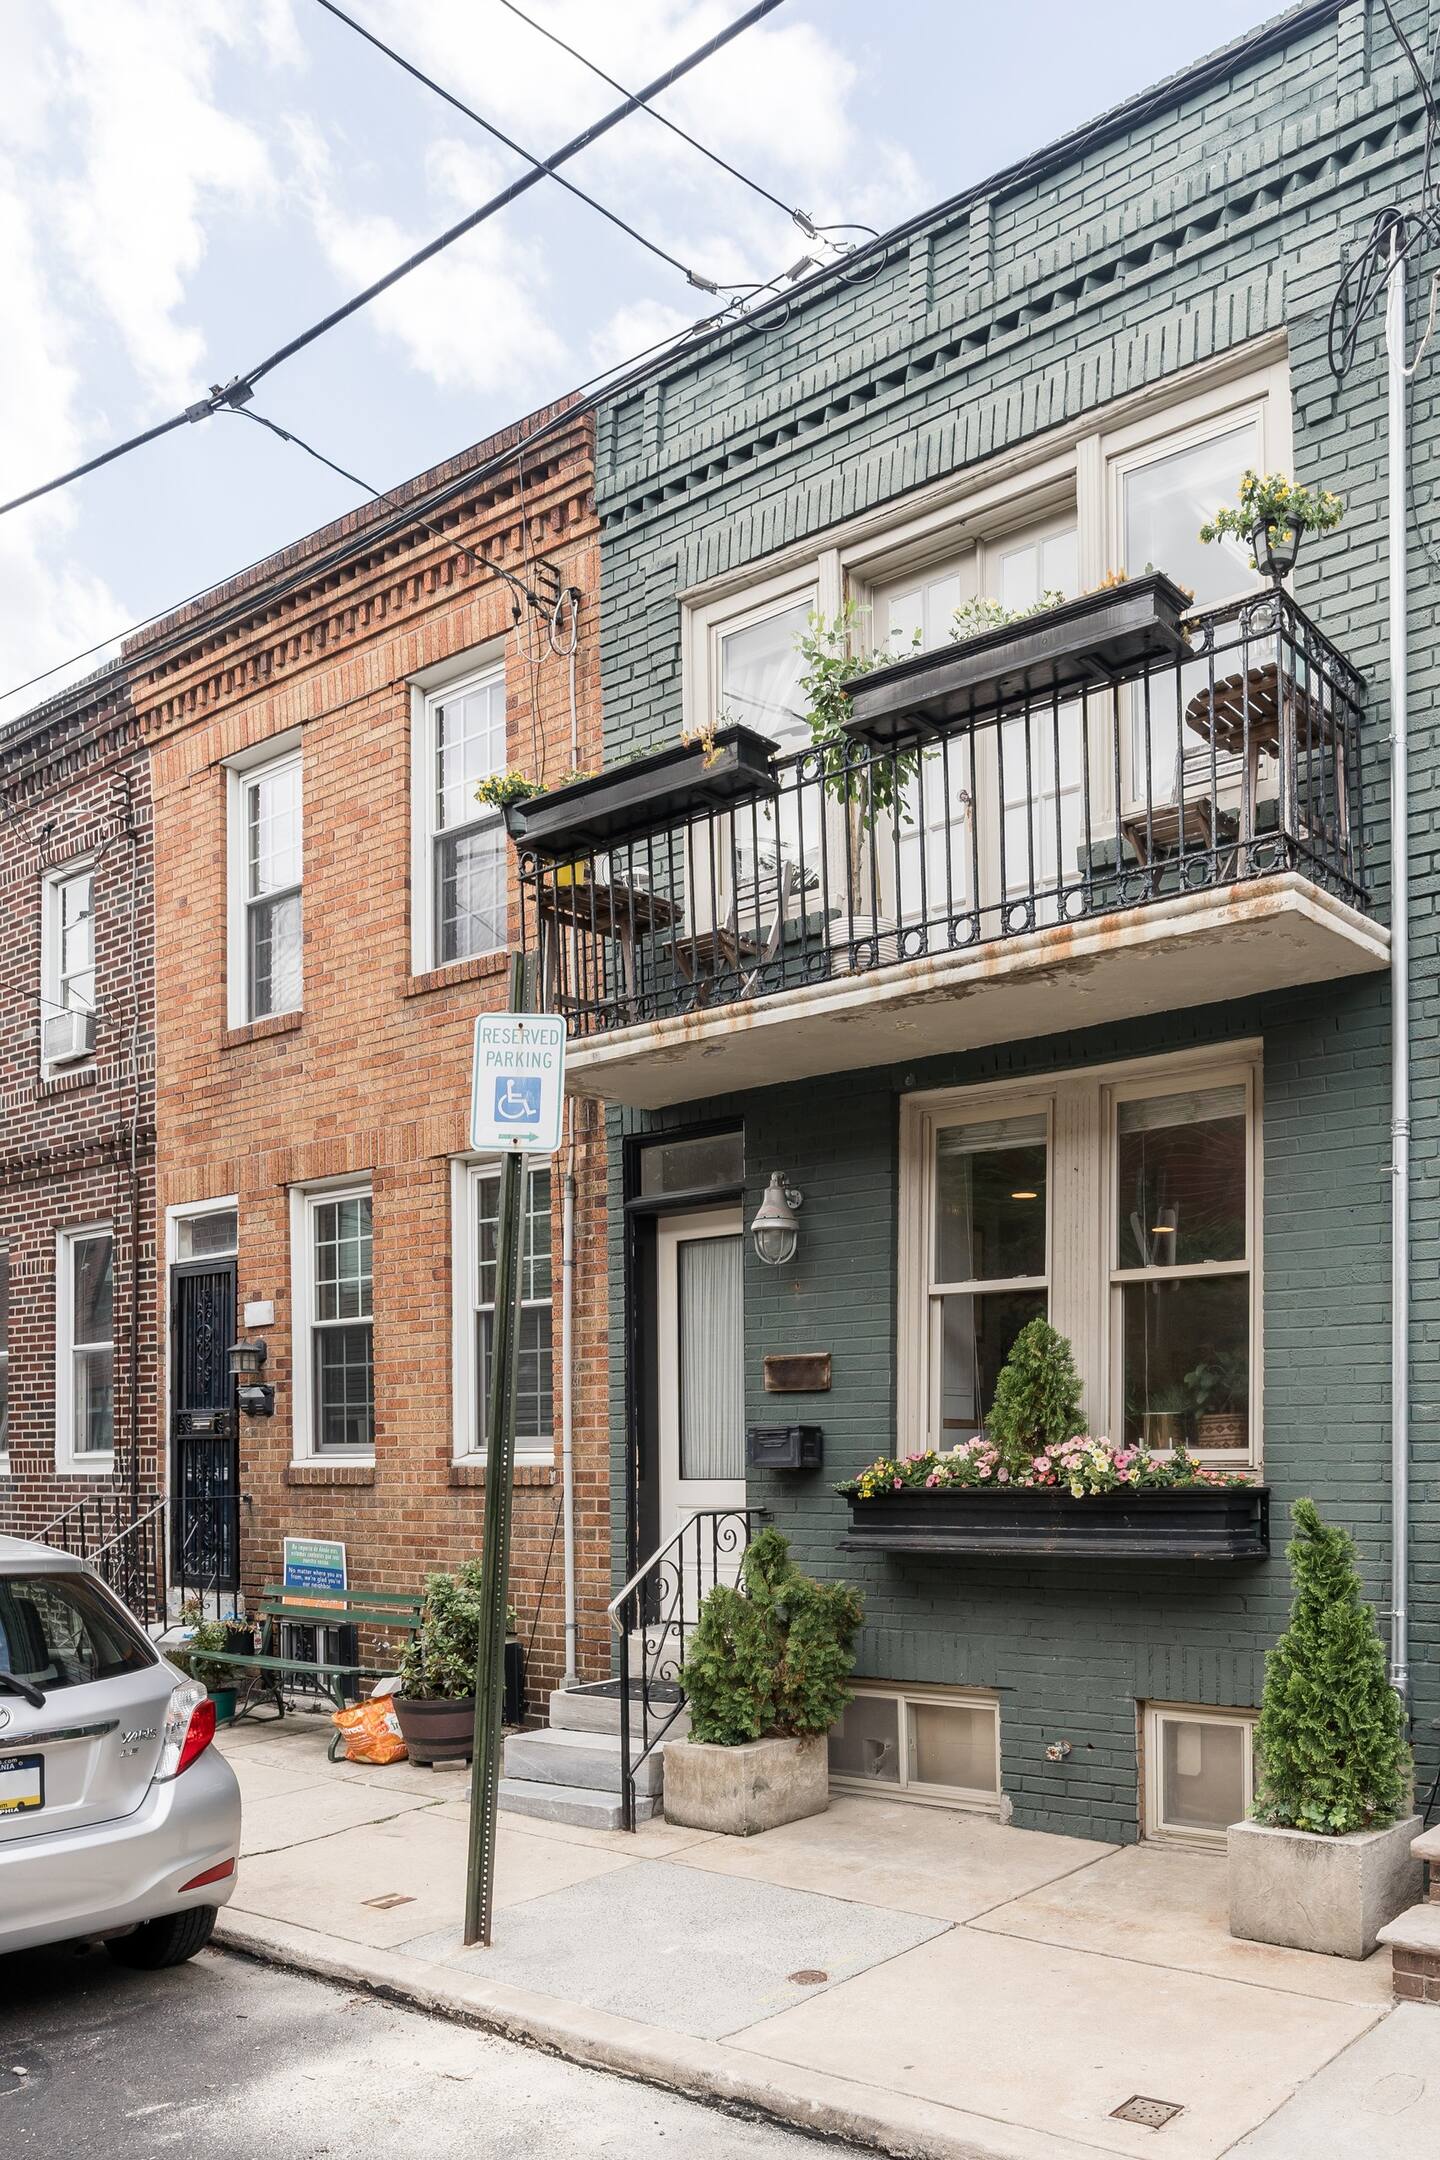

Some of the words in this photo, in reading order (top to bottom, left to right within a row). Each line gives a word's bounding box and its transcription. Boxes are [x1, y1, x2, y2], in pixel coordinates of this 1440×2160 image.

[482, 1027, 559, 1046] RESERVED
[486, 1051, 552, 1069] PARKING
[313, 1569, 326, 1577] where
[317, 1576, 328, 1584] glad
[121, 1727, 157, 1744] YARIS
